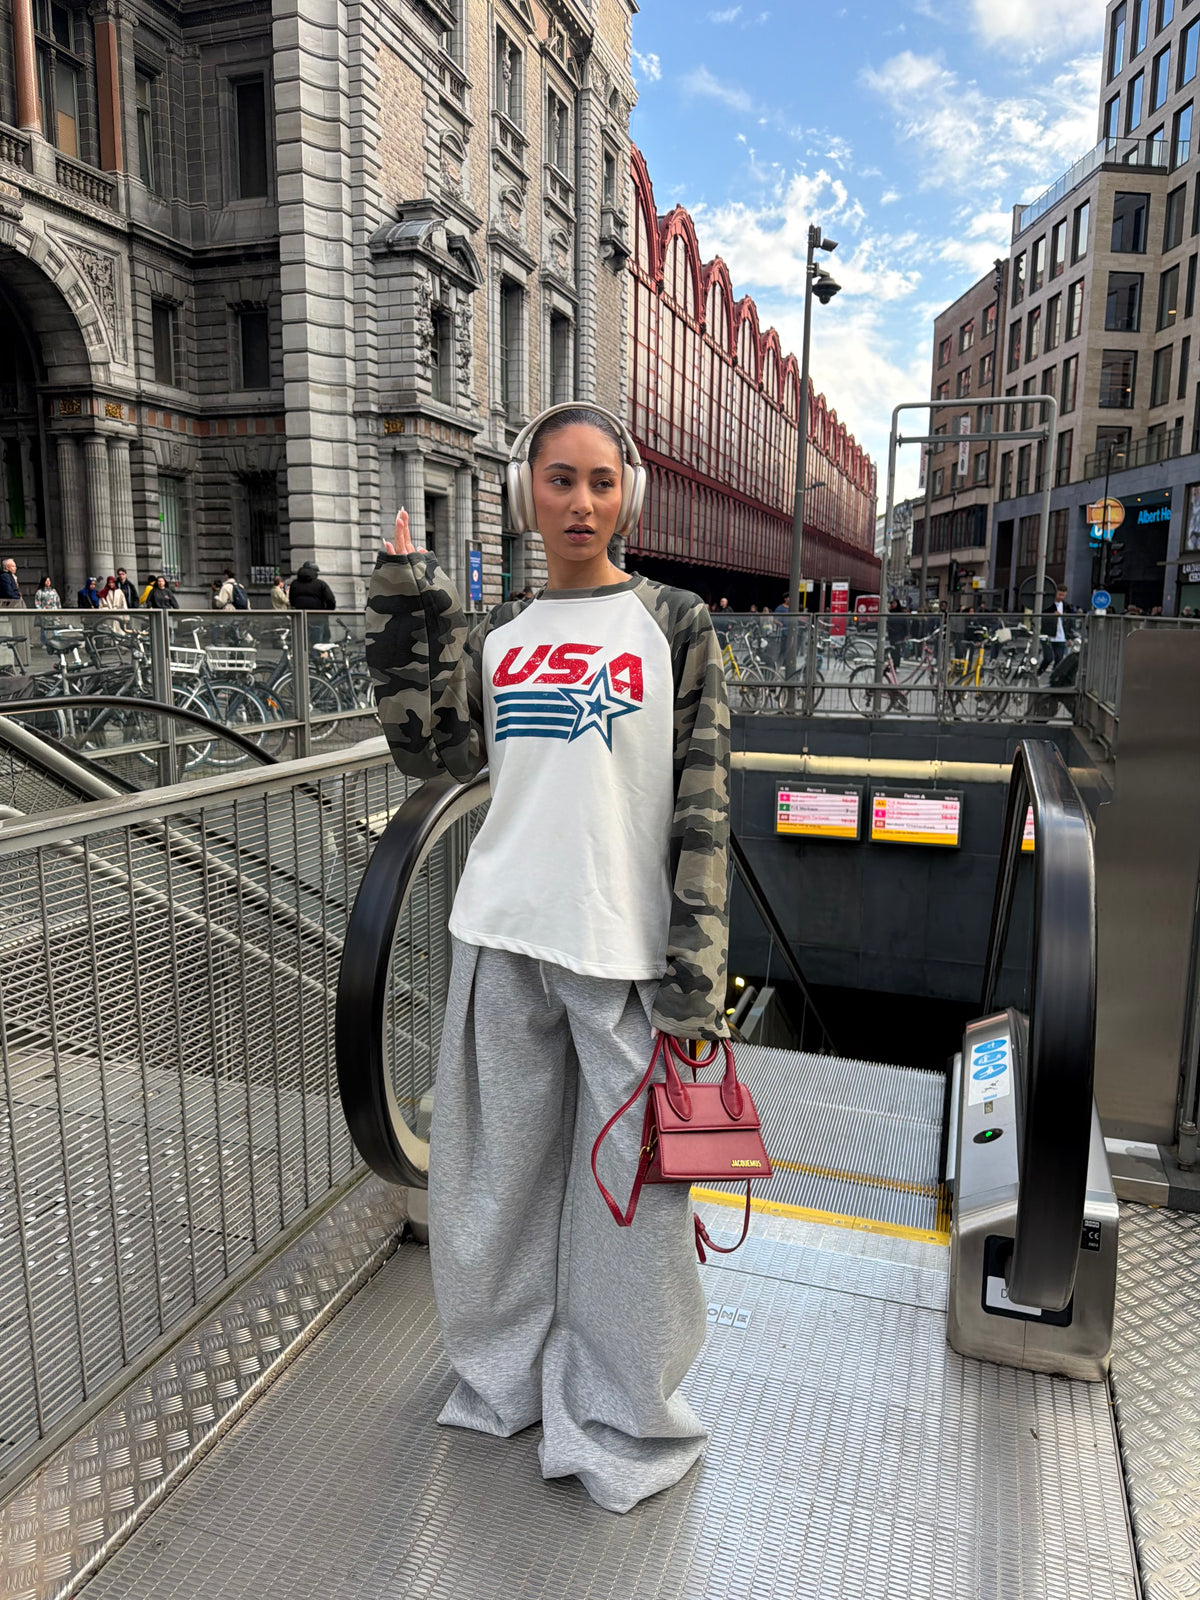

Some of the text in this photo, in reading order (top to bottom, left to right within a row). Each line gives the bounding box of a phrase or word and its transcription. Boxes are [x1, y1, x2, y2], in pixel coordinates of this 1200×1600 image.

[1137, 509, 1160, 525] Albert
[492, 643, 644, 703] USA
[731, 1159, 762, 1168] JACQUEMUS
